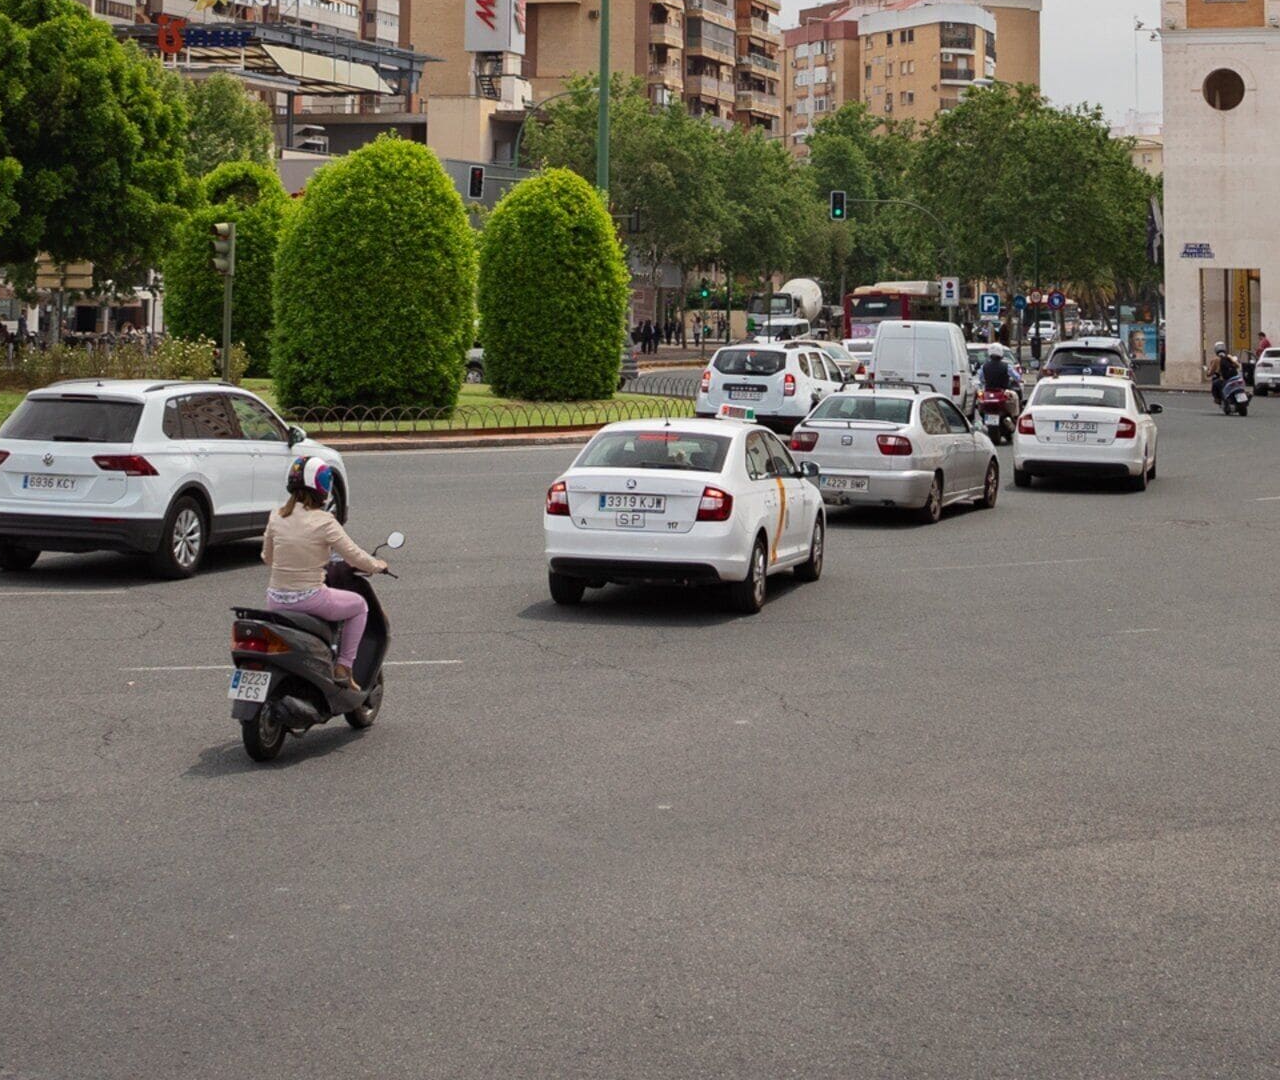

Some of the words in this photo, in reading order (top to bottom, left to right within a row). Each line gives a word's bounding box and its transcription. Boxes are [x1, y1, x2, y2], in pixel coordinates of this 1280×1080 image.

[983, 296, 996, 311] P
[29, 476, 54, 488] 6936
[57, 477, 77, 489] KCY
[607, 495, 636, 507] 3319
[619, 513, 641, 525] SP
[241, 671, 269, 686] 6223
[237, 686, 261, 700] FCS
